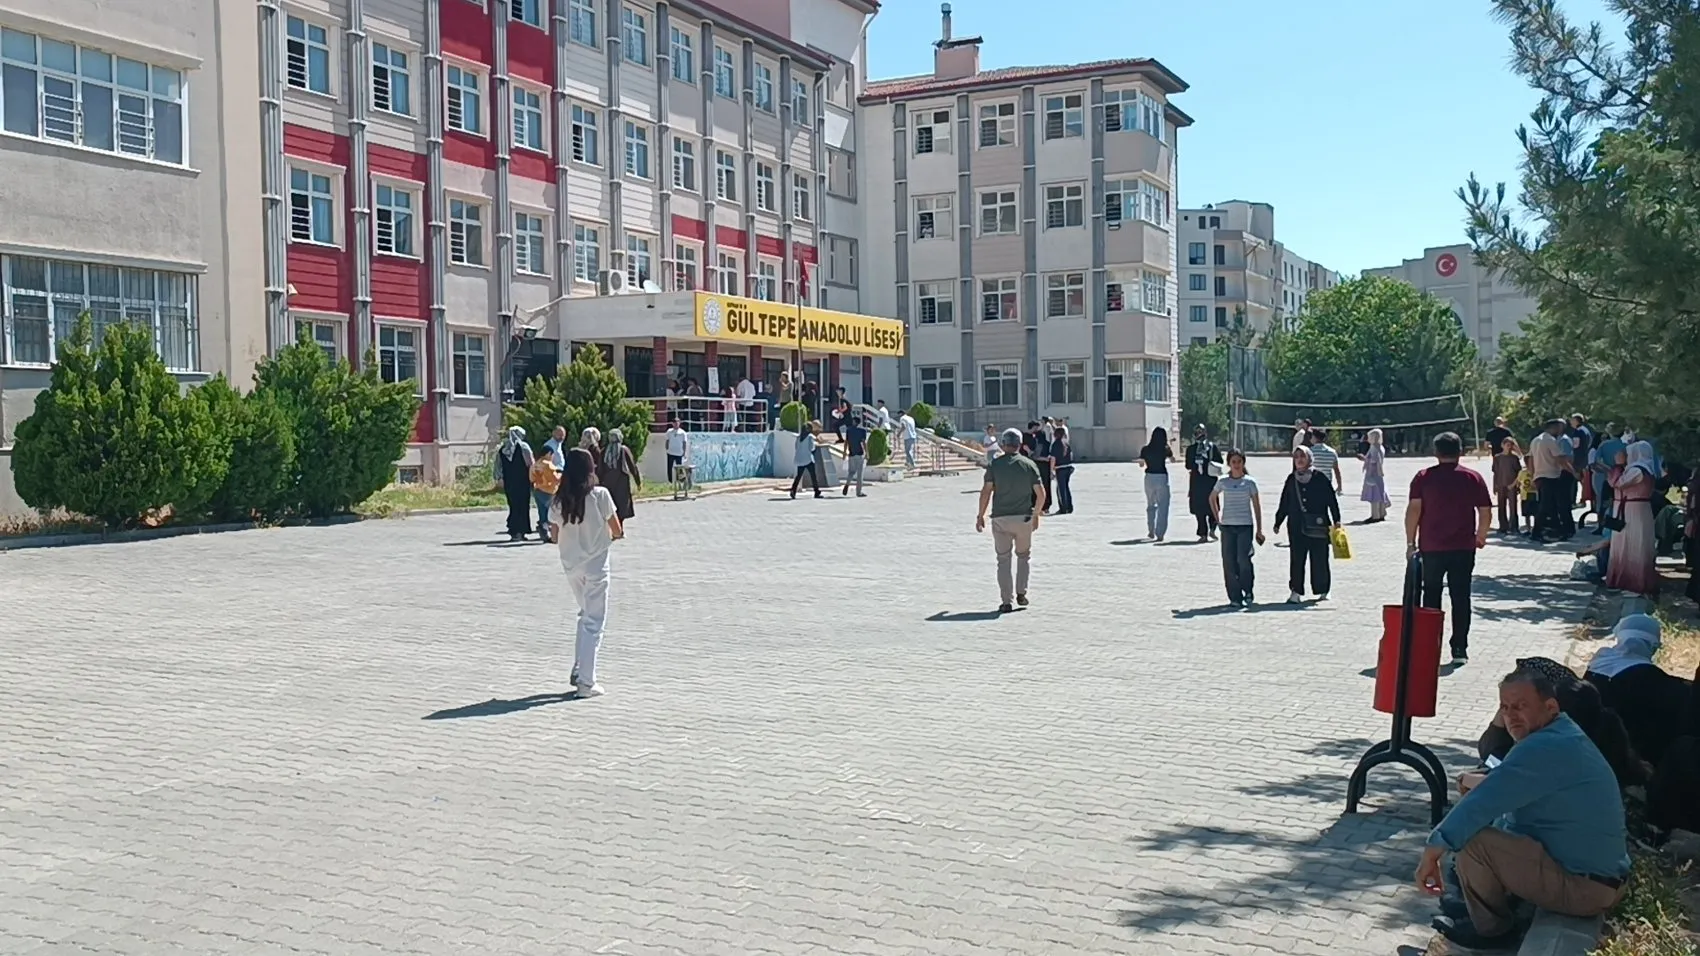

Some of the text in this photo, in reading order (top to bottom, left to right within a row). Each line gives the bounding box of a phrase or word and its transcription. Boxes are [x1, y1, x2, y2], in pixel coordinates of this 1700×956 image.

[727, 304, 900, 350] GÜLTEPE ANADOLU LİSESİ
